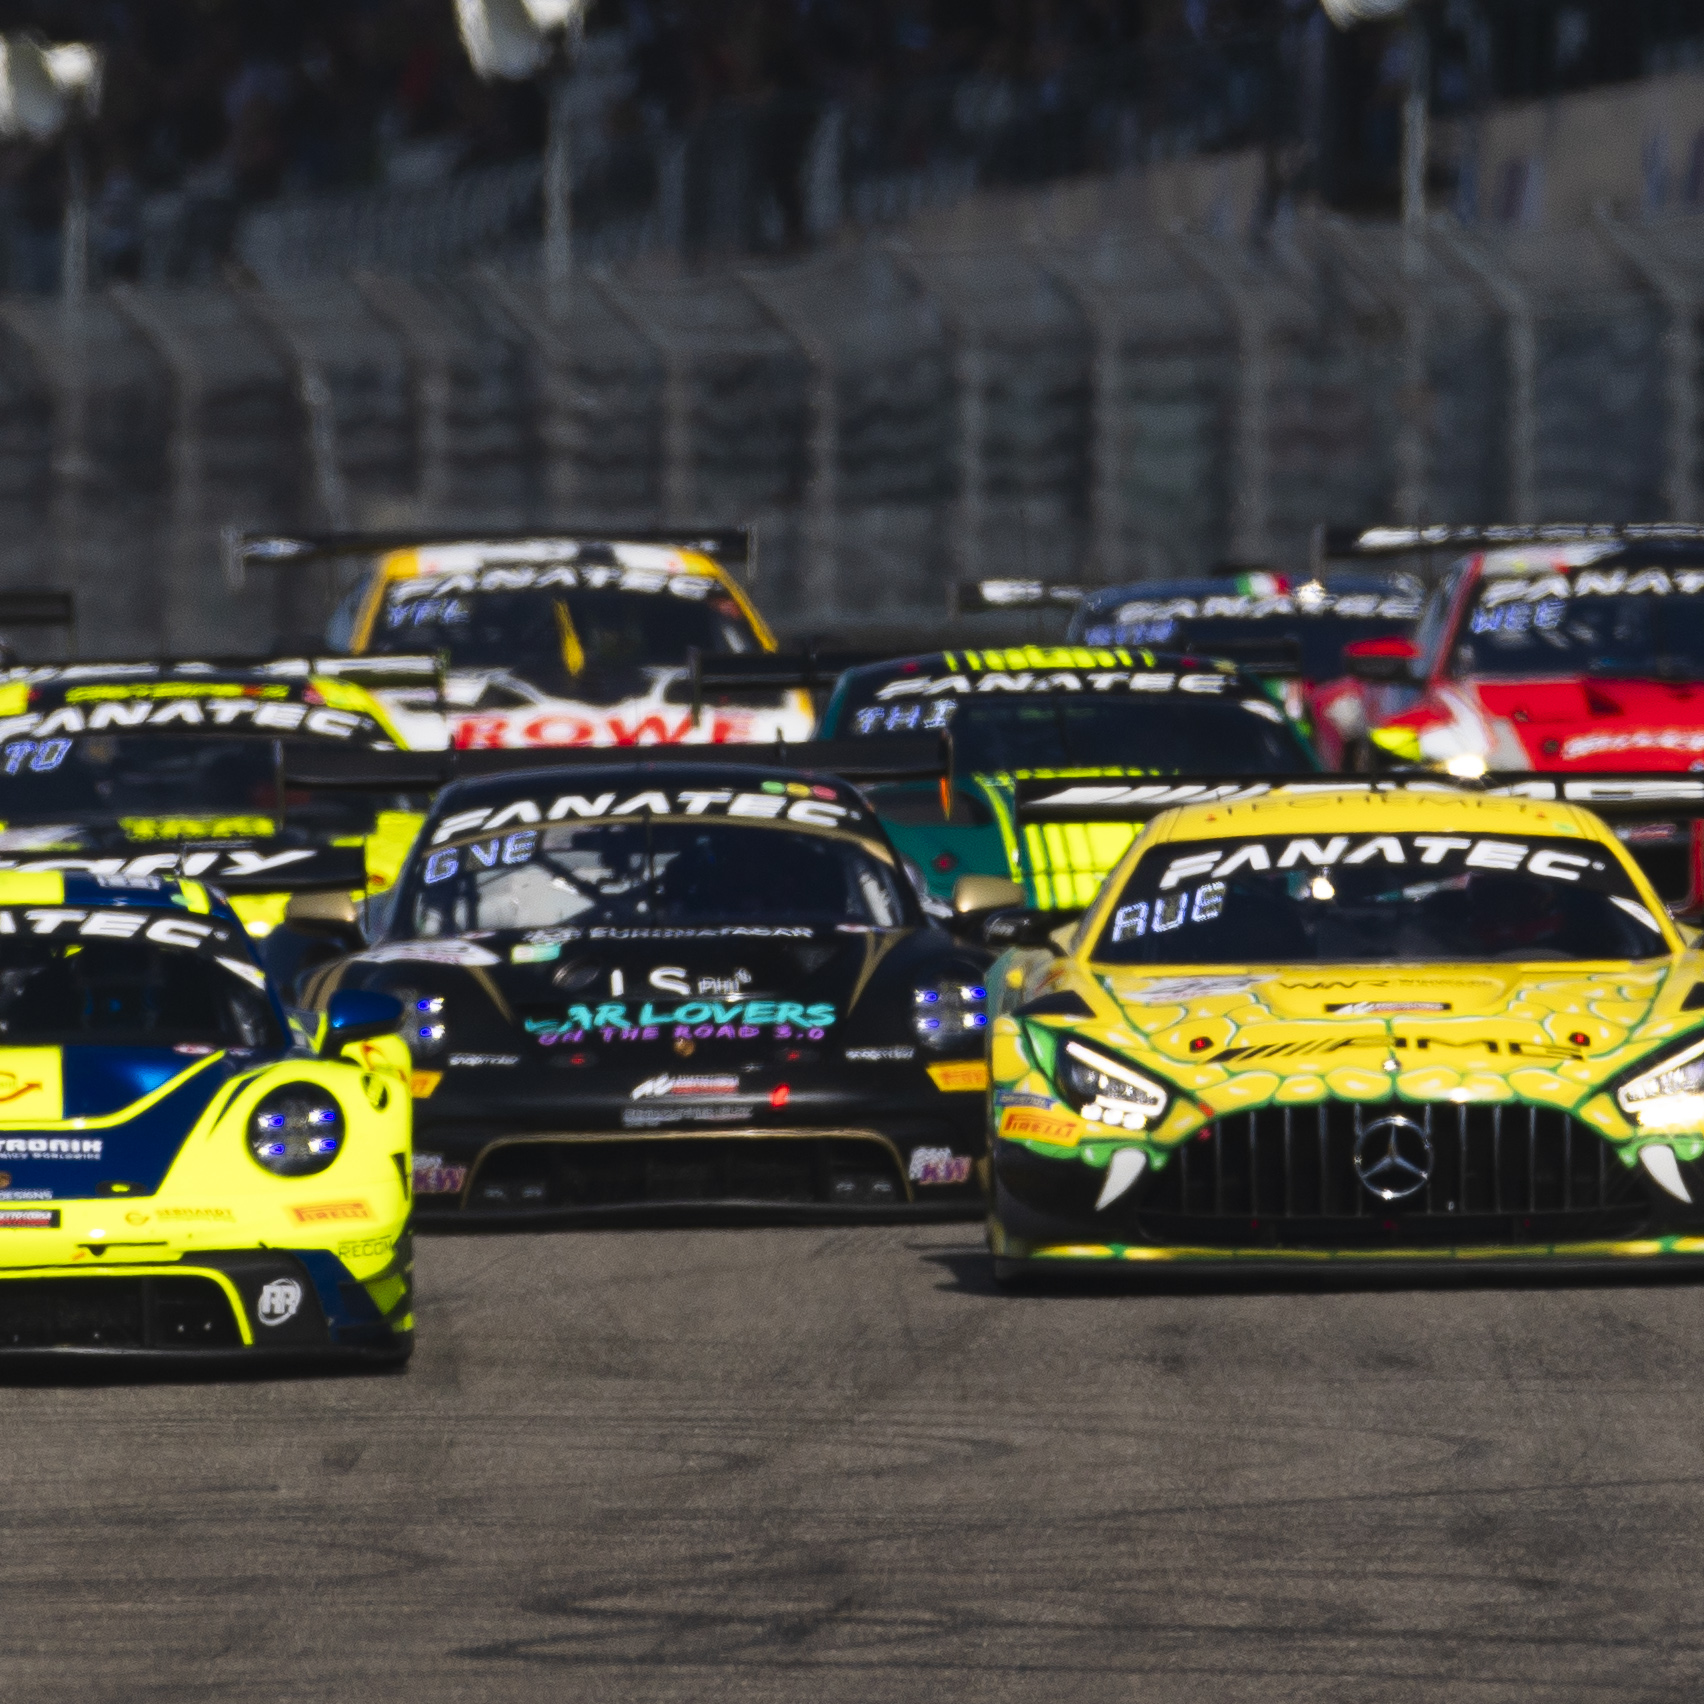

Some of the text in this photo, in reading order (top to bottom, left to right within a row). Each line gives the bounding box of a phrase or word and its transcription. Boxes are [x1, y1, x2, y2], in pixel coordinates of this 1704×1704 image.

[875, 671, 1226, 701] FANATEC
[455, 714, 755, 750] ROWE
[431, 790, 849, 846] FANATEC
[1158, 836, 1595, 889] FANATEC
[638, 1000, 837, 1029] LOVERS
[538, 1028, 586, 1045] ON
[601, 1025, 660, 1043] THE
[673, 1024, 760, 1040] ROAD
[1004, 1113, 1077, 1140] PIRELLI
[293, 1202, 370, 1223] PIRELLI
